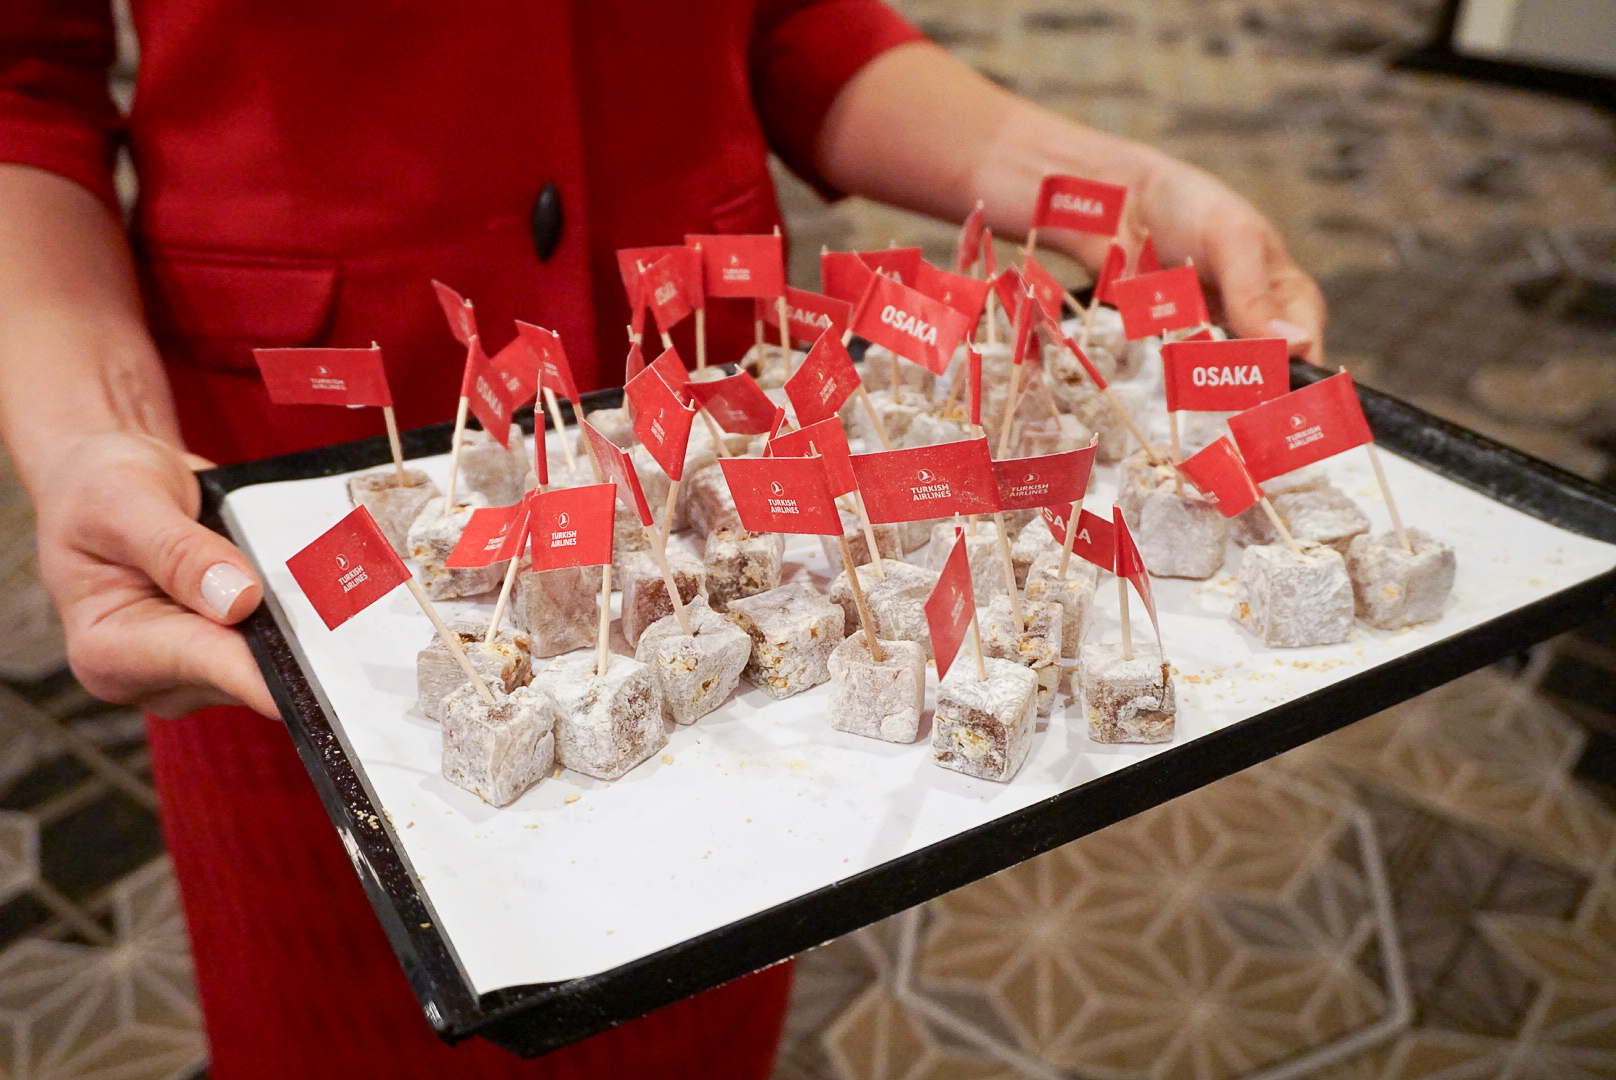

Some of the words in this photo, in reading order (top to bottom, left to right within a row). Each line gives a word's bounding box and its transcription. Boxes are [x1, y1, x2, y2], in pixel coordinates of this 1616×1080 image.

[1051, 192, 1103, 216] OSAKA
[881, 305, 938, 346] OSAKA
[1193, 365, 1264, 386] OSAKA
[476, 375, 503, 419] OSAKA
[1285, 425, 1322, 442] TURKISH
[1289, 432, 1325, 450] AIRLINES
[910, 483, 950, 495] TURKISH
[913, 490, 952, 502] AIRLINES
[1009, 488, 1049, 498] AIRLINES
[1011, 483, 1050, 492] TURKISH
[767, 498, 797, 507] TURKISH
[771, 506, 800, 514] AIRLINES
[1040, 506, 1092, 545] SAA
[550, 538, 577, 548] AIRLINES
[551, 530, 577, 540] TURKISH
[338, 564, 364, 586] TURKISH
[343, 572, 369, 593] AIRLINES
